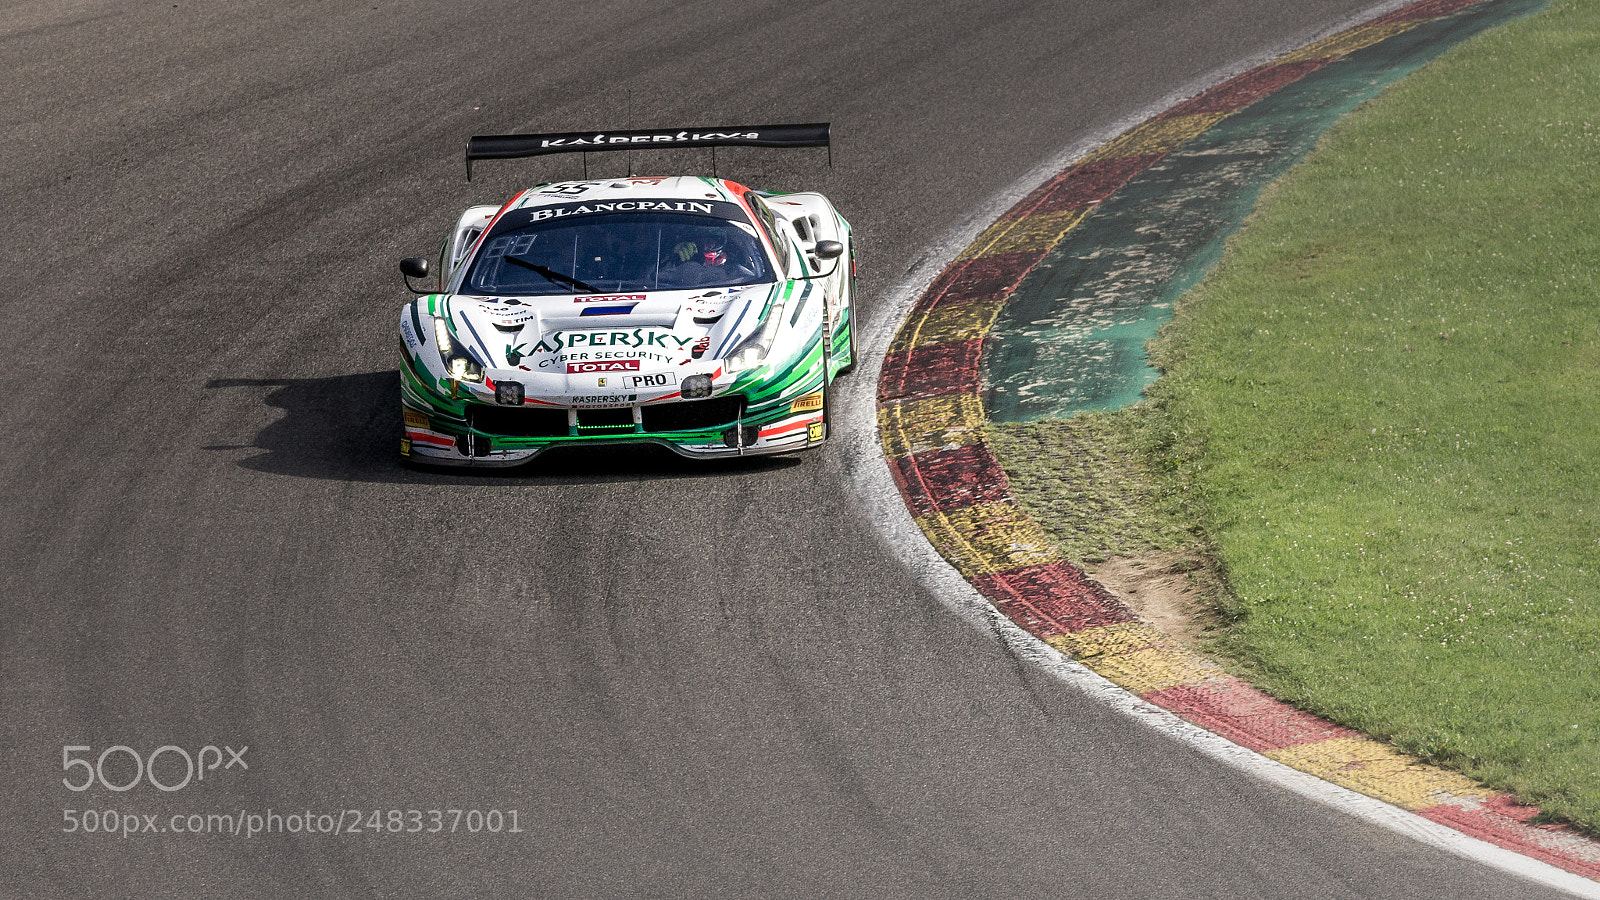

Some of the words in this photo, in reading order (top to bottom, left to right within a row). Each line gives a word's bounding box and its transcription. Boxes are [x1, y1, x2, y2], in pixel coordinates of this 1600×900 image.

[541, 131, 743, 148] KASPERSKY
[530, 201, 714, 222] BLANCPAIN
[506, 329, 693, 358] KASPERSKY
[538, 352, 588, 368] CYBER
[595, 351, 673, 364] SECURITY
[569, 362, 638, 372] TOTAL
[632, 374, 667, 387] PRO
[793, 395, 821, 408] PIRELLI
